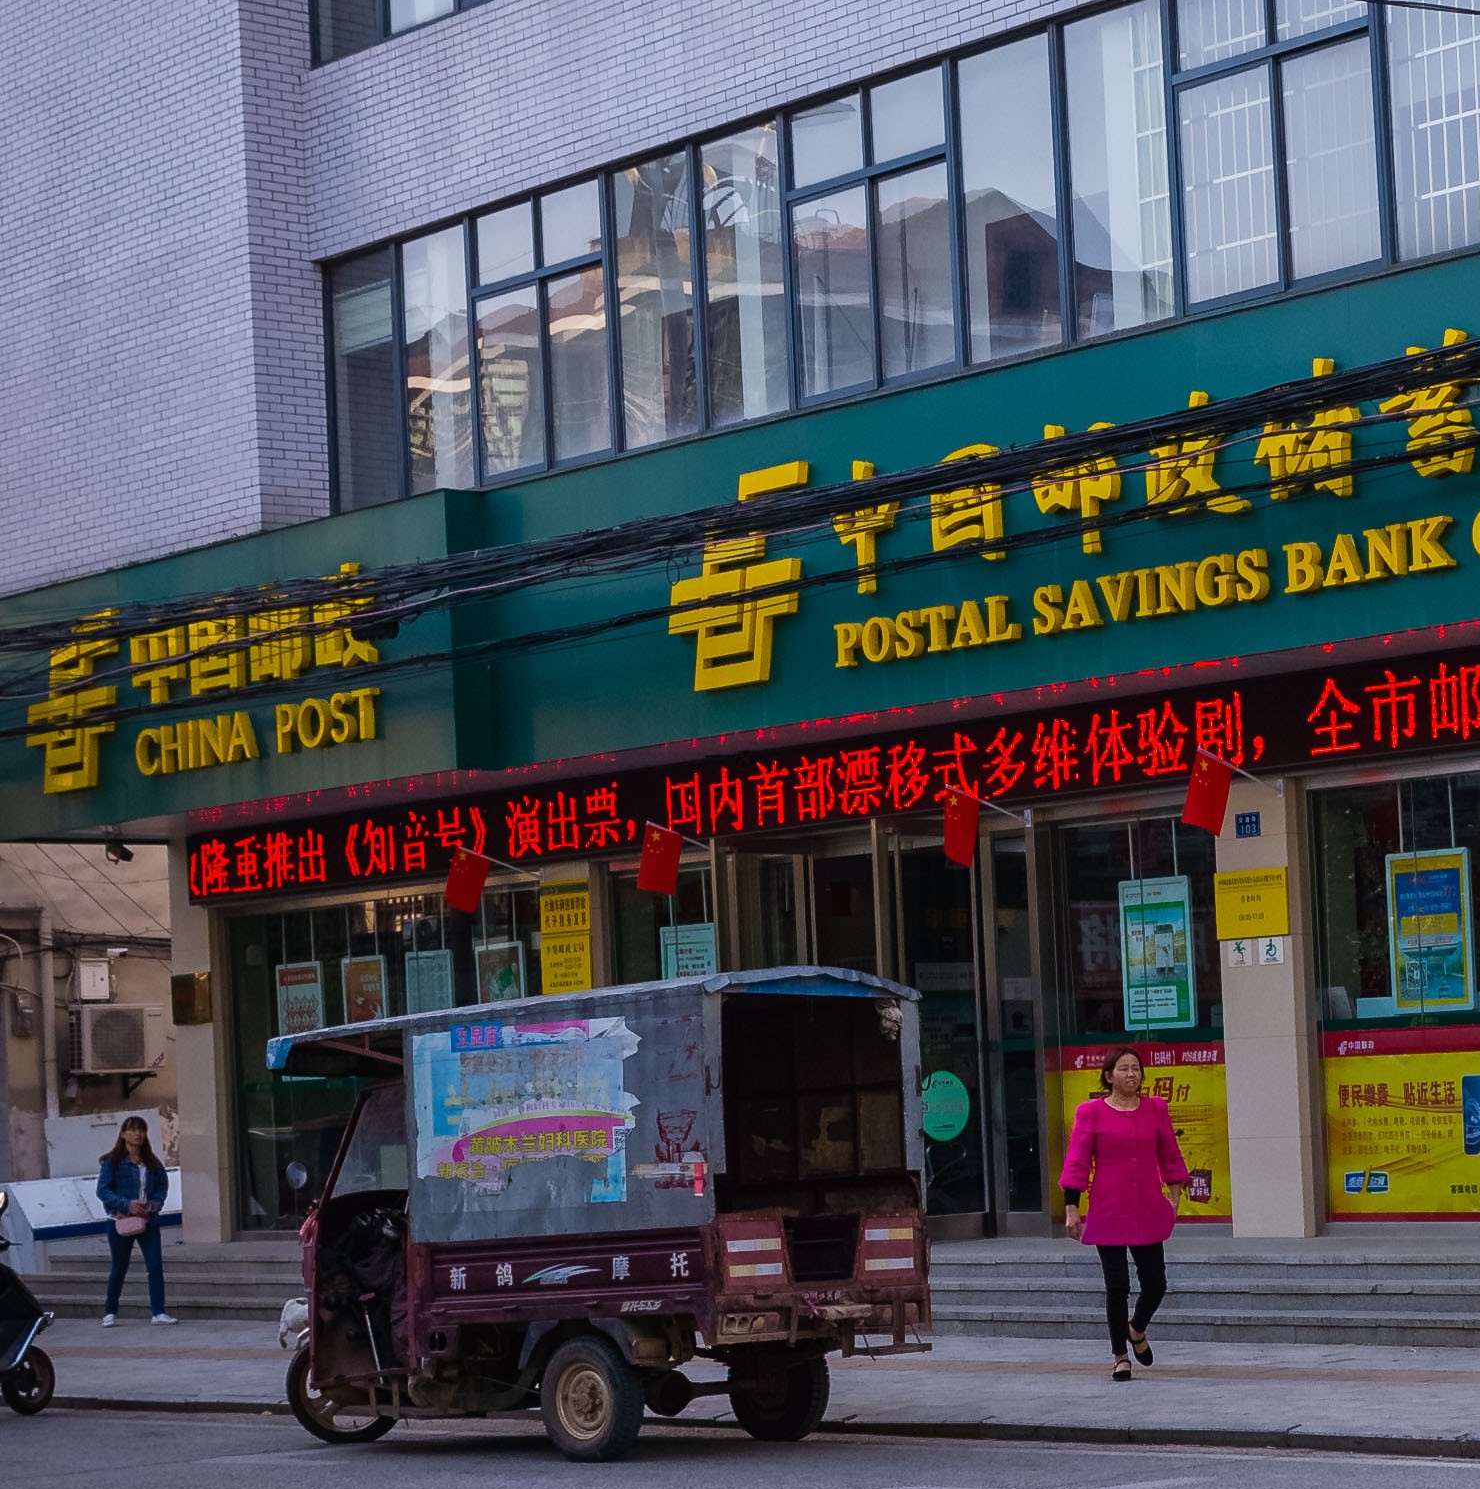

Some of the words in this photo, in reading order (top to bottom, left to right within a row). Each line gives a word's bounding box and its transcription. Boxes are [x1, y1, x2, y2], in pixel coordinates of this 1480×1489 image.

[834, 595, 1021, 668] POSTAL
[1033, 548, 1269, 634] SAVINGS
[1283, 515, 1456, 594] BANK
[136, 710, 260, 776] CHINA
[276, 688, 379, 753] POST
[1241, 823, 1257, 836] 103
[1403, 1080, 1456, 1107] 贴近生活
[470, 1129, 608, 1156] 黄陂木兰妇科医院
